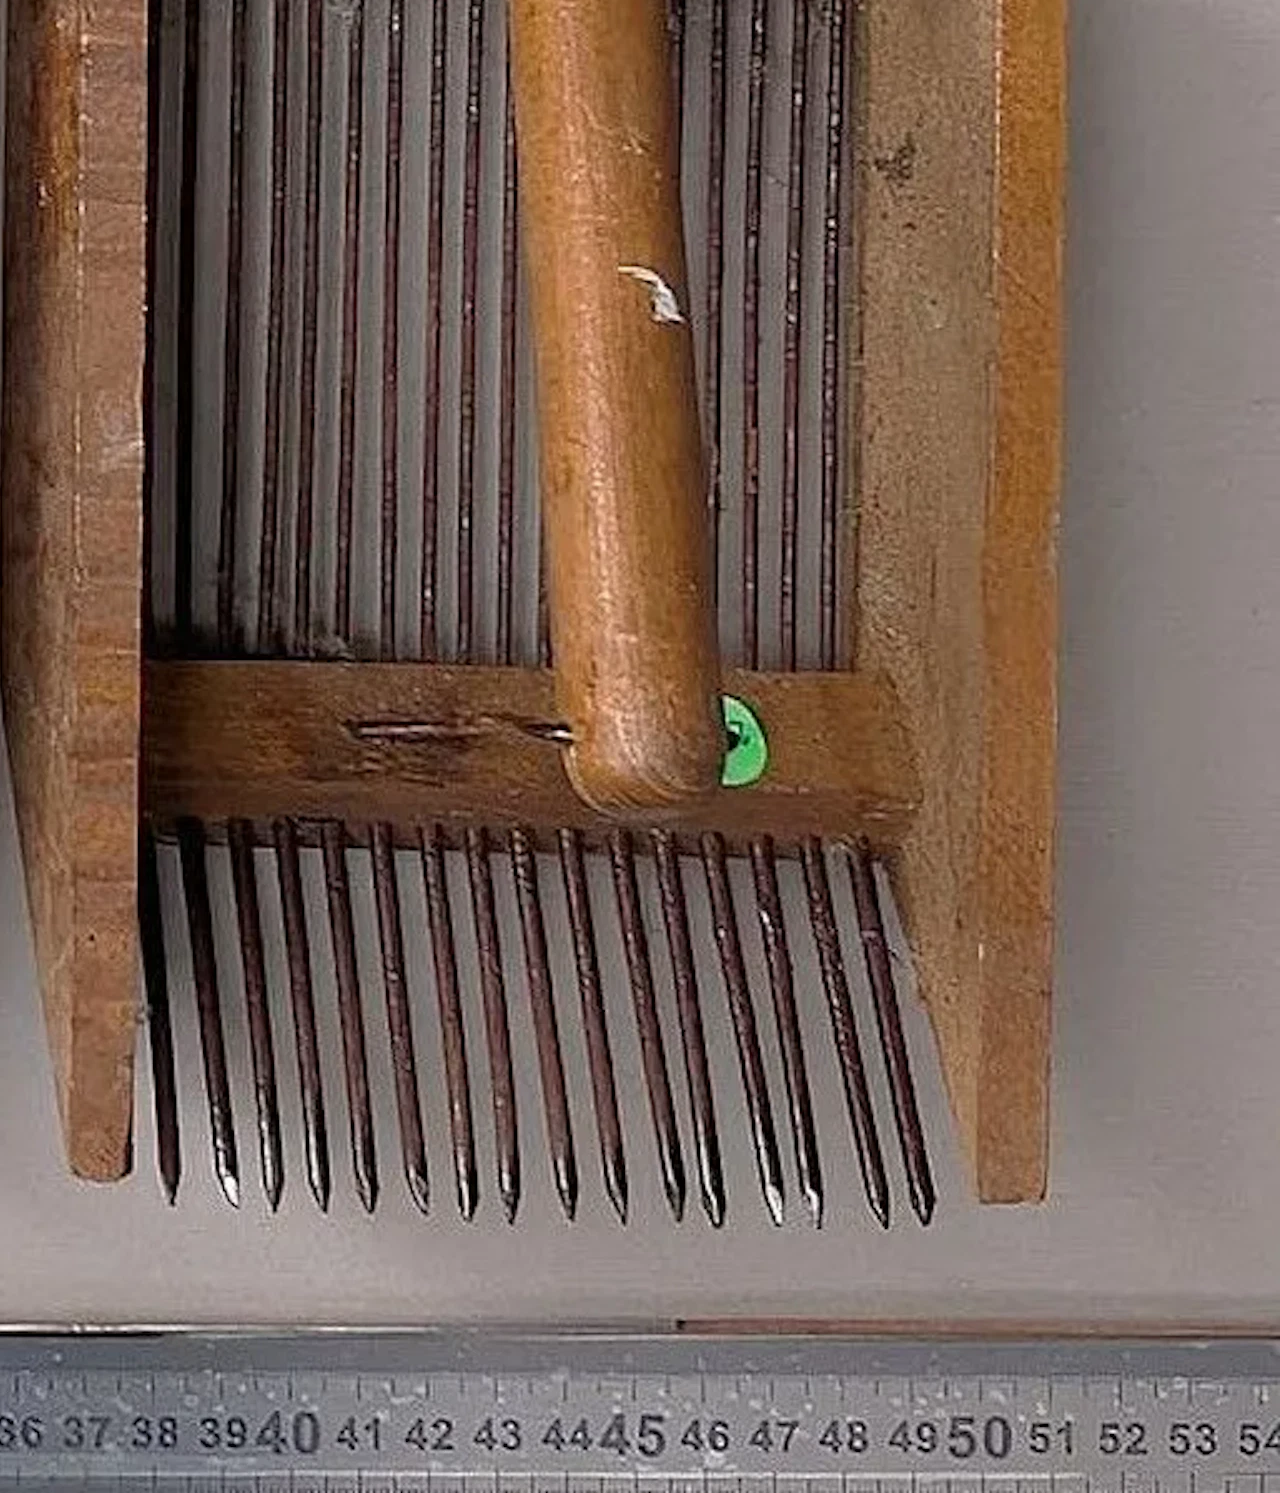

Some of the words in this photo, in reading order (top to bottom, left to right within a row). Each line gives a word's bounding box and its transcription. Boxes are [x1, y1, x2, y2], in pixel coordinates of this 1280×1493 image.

[64, 1416, 109, 1448] 37
[132, 1416, 178, 1449] 38
[199, 1417, 247, 1449] 39
[256, 1410, 320, 1455] 40
[336, 1417, 380, 1451] 41
[404, 1417, 455, 1451] 42
[473, 1417, 522, 1451] 43
[541, 1418, 593, 1452] 44
[599, 1413, 666, 1458] 45
[680, 1419, 730, 1453] 46
[749, 1420, 800, 1454] 47
[818, 1420, 869, 1454] 48
[888, 1420, 937, 1454] 49
[948, 1415, 1012, 1459] 50
[1029, 1420, 1073, 1455] 51
[1099, 1422, 1148, 1456] 52
[1169, 1423, 1217, 1456] 53
